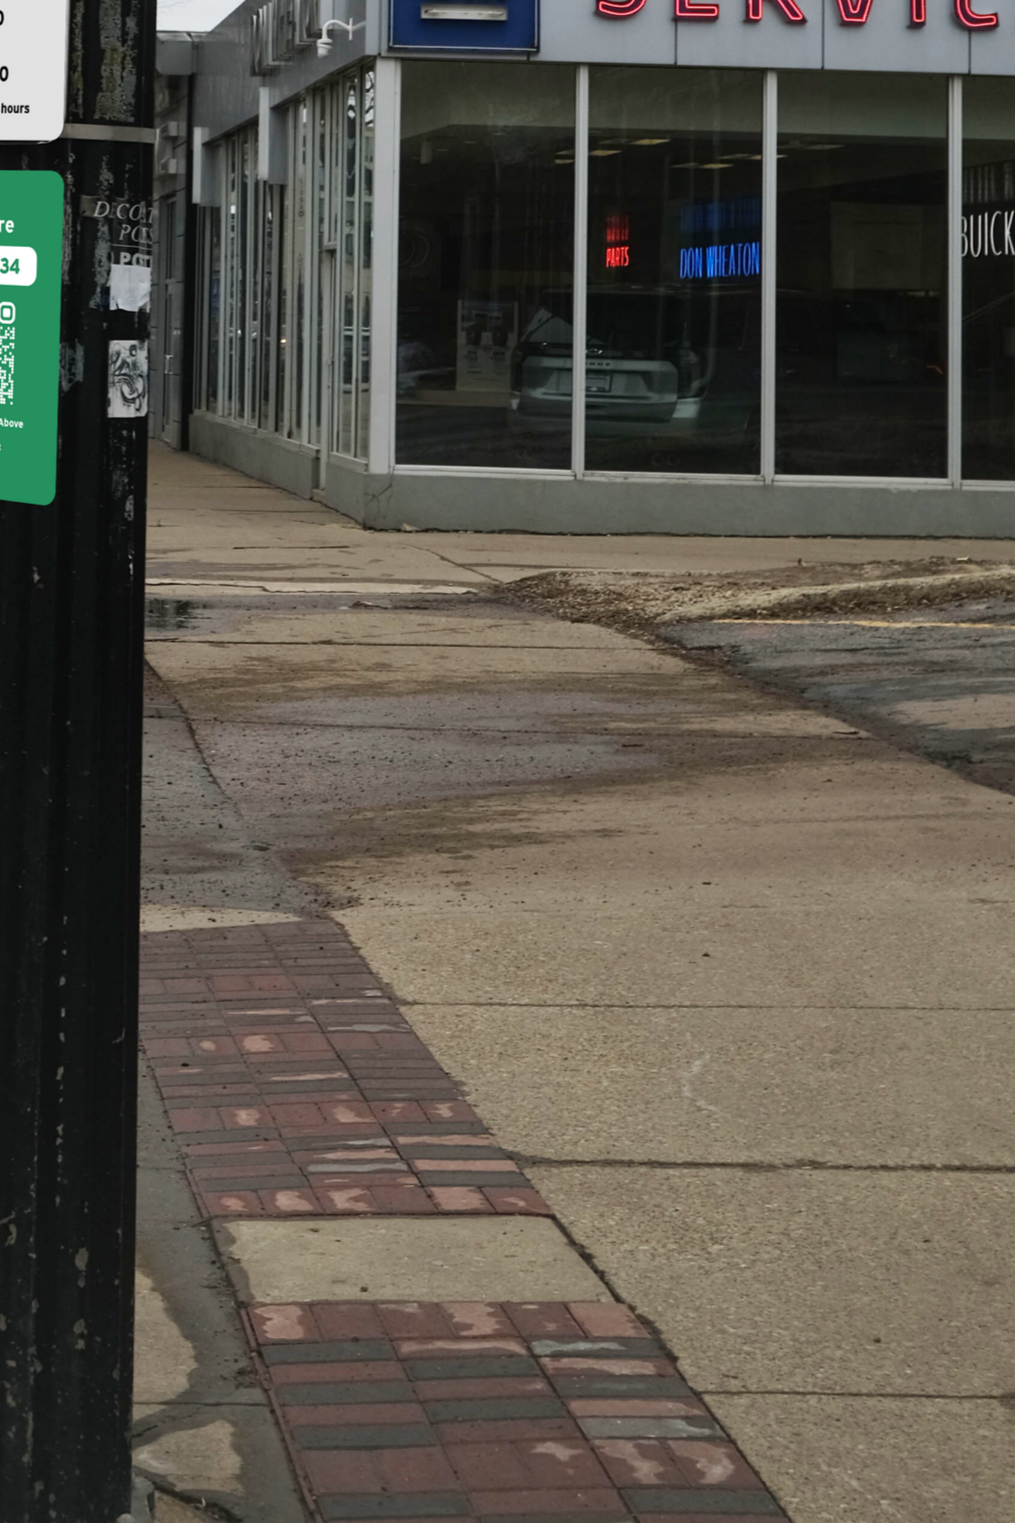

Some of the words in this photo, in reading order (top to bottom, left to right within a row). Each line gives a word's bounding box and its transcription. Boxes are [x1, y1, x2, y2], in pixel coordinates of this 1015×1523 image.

[0, 102, 31, 115] hours
[605, 246, 630, 268] PARTS
[679, 246, 703, 279] DON
[705, 241, 761, 278] WHEATON
